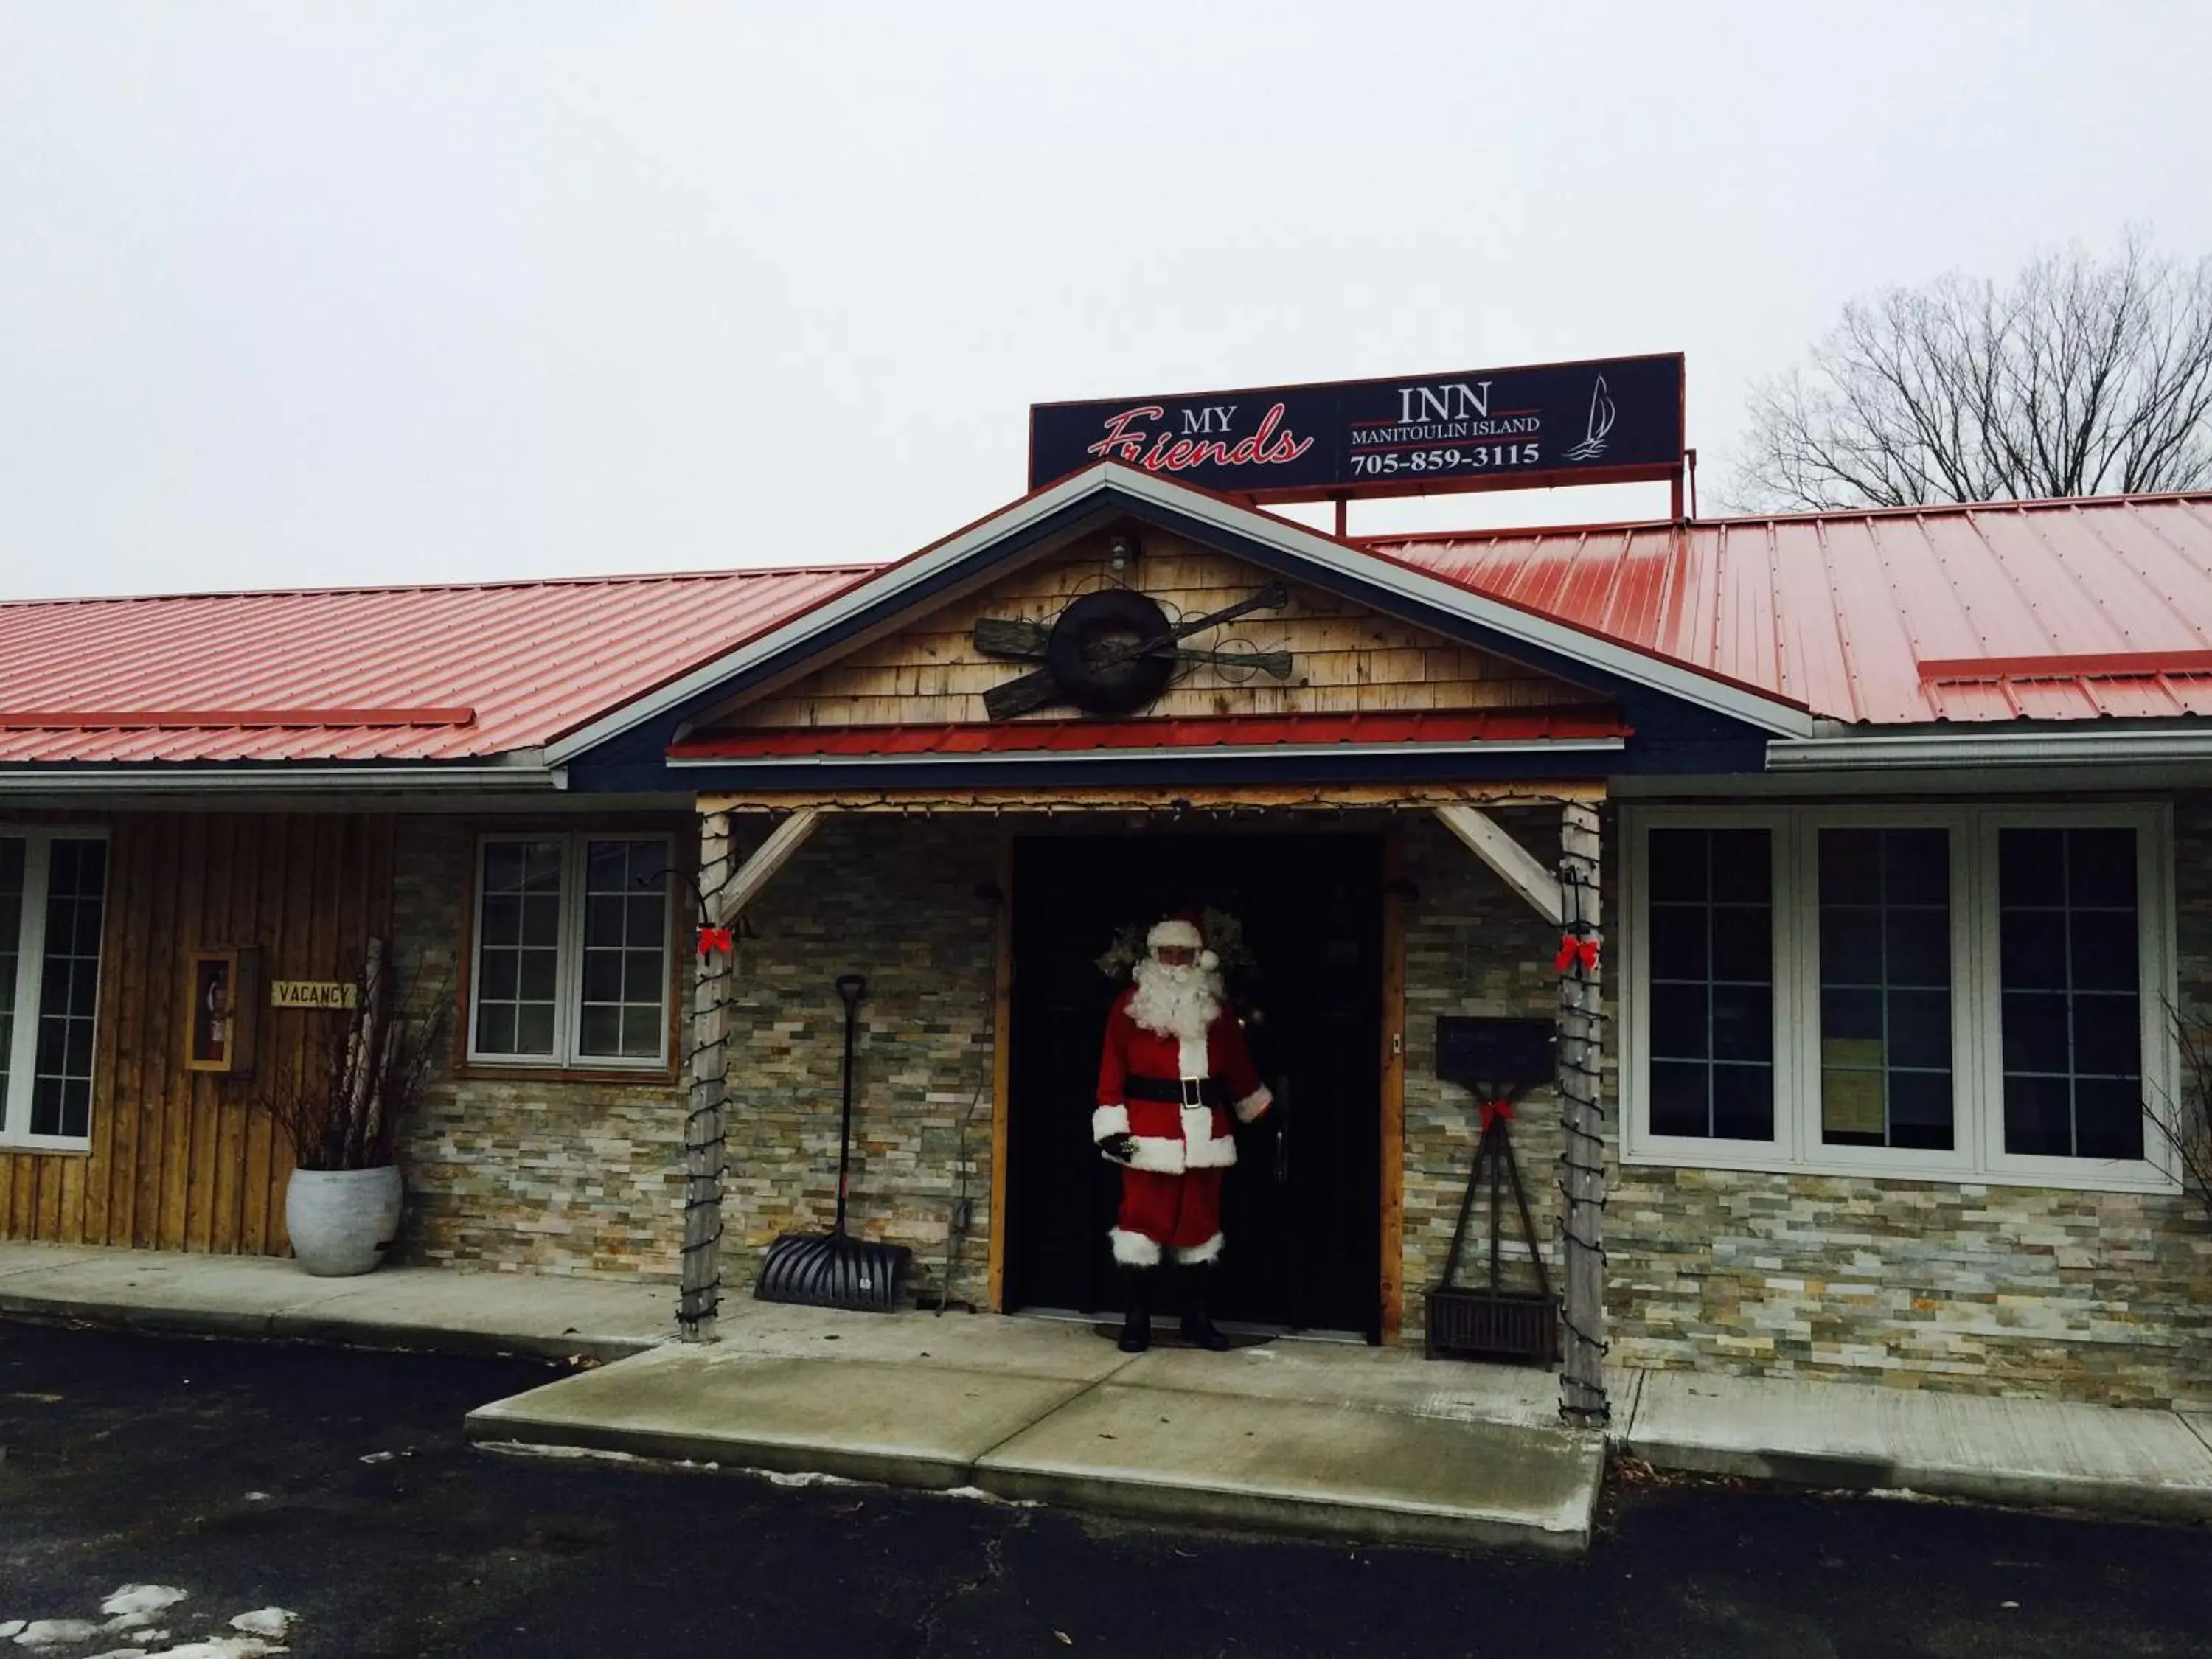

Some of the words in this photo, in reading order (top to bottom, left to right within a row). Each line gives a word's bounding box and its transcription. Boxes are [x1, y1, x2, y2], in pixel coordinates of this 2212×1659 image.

[1397, 381, 1493, 424] INN
[1181, 406, 1238, 434] MY
[1352, 422, 1467, 445] MANITOULIN
[1473, 417, 1541, 436] ISLAND
[1350, 443, 1540, 476] 705-859-3115
[280, 984, 349, 1004] VACANCY
